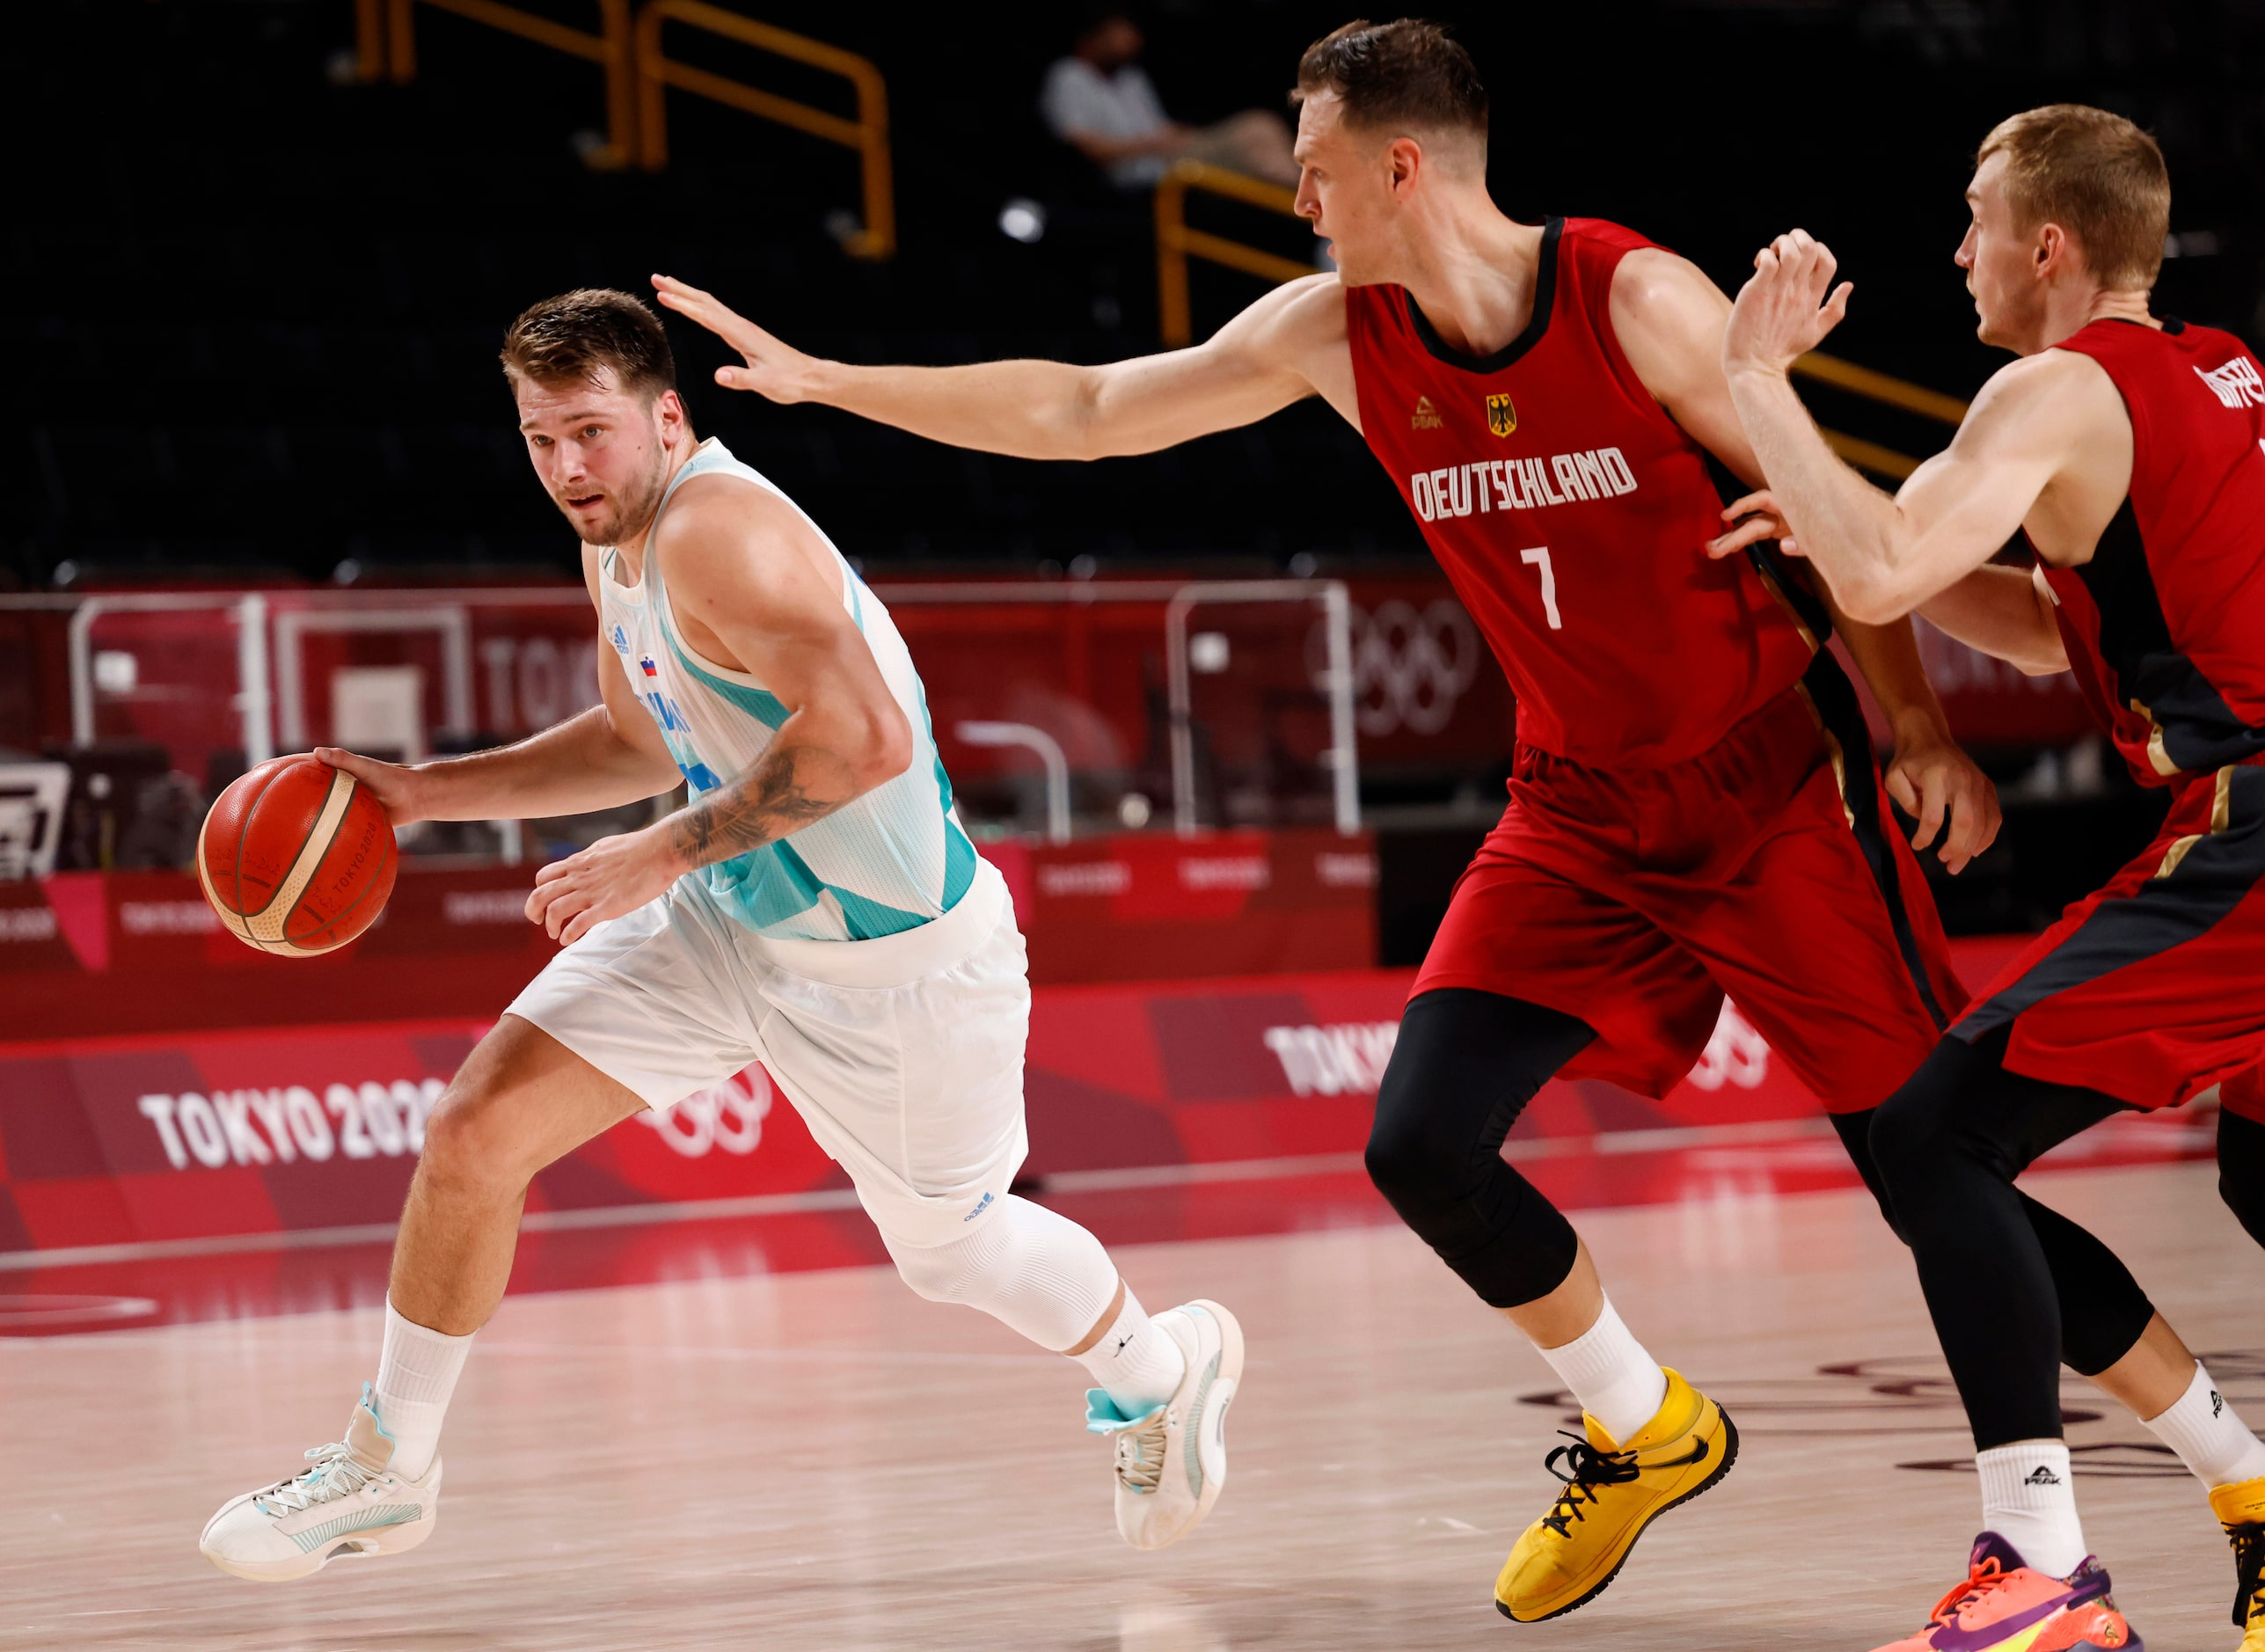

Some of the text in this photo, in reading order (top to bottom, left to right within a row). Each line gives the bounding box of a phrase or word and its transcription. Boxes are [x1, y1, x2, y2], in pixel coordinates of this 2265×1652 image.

[1412, 447, 1638, 522] DEUTSCHLAND
[1520, 546, 1562, 629] 7
[332, 822, 376, 893] TOKYO 2020
[138, 1085, 334, 1171] TOKYO
[2025, 1477, 2062, 1486] PEAK
